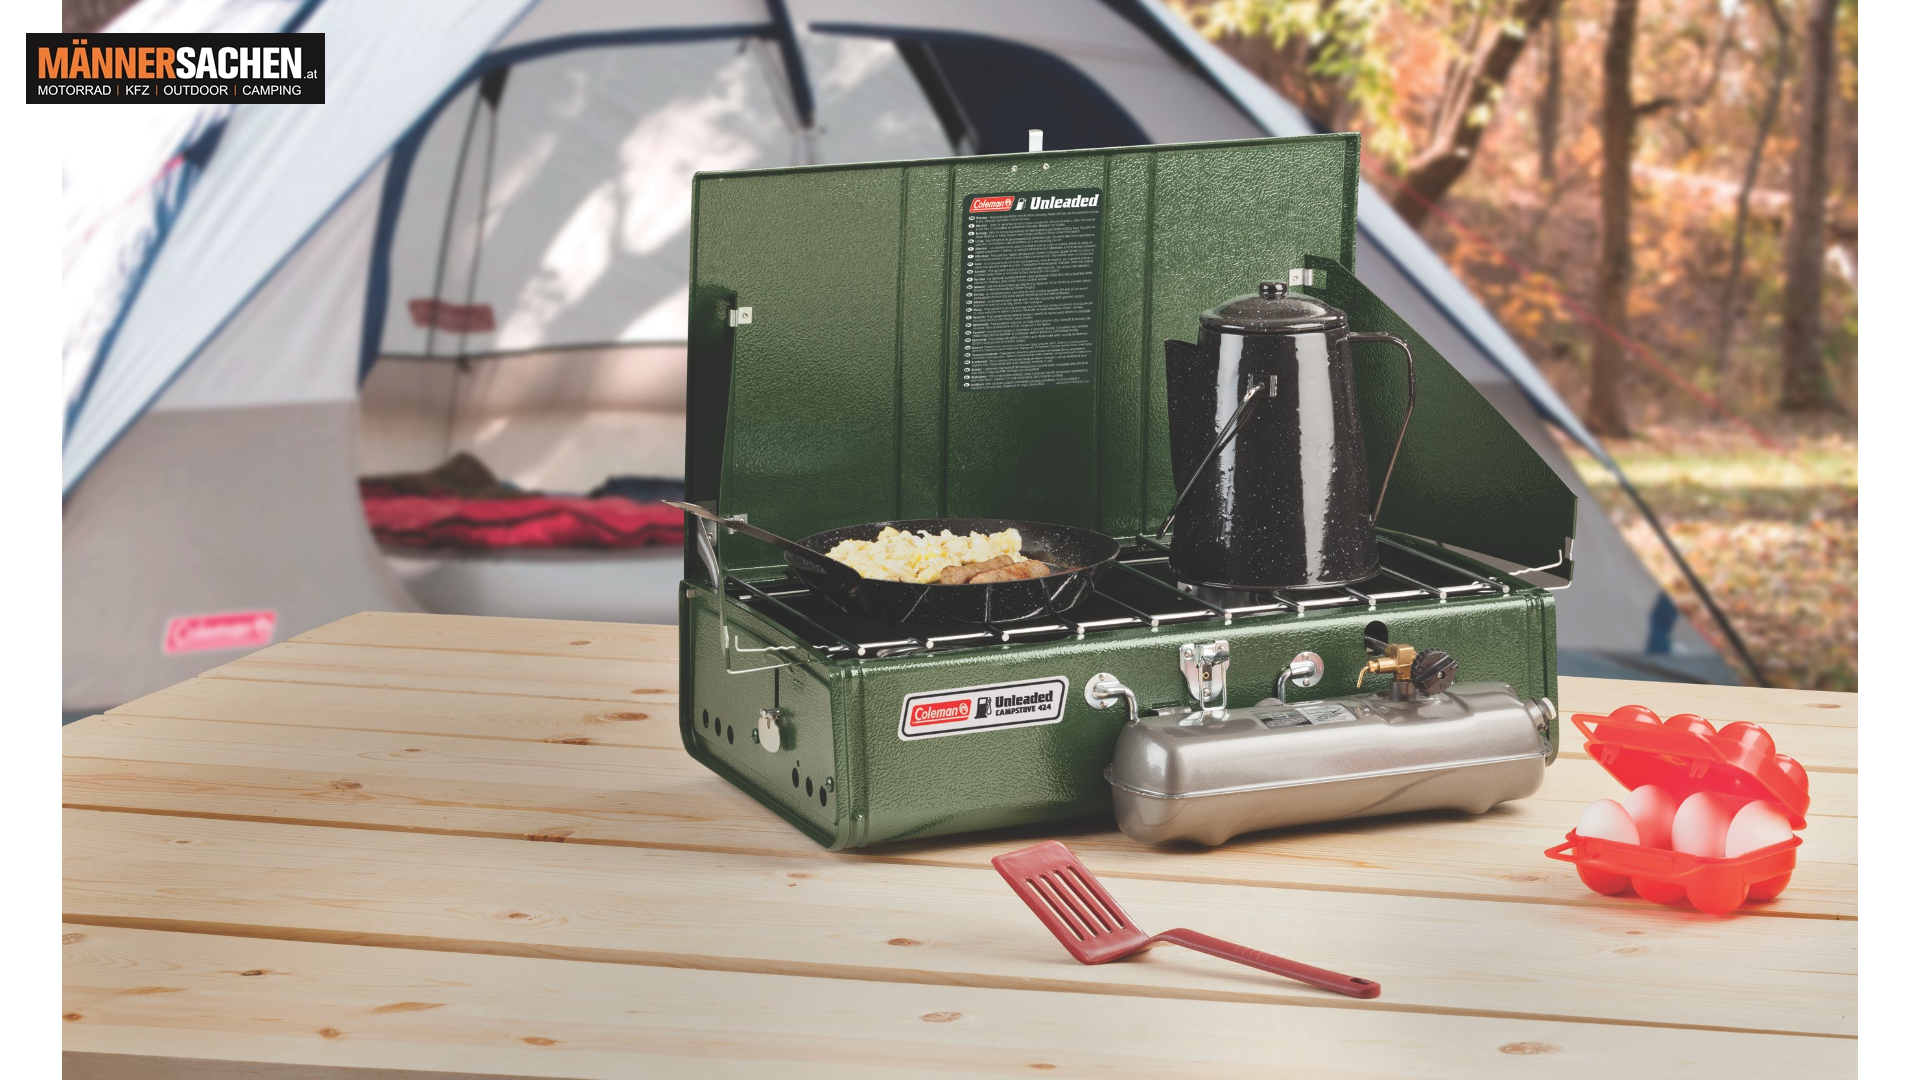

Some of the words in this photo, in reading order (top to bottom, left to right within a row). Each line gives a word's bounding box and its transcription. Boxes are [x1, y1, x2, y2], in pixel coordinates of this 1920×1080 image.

[973, 199, 1004, 209] Coleman
[1030, 194, 1100, 210] Unleaded
[914, 706, 959, 721] Coleman
[995, 690, 1053, 708] Unleaded
[996, 706, 1036, 716] CAMPSTOVE
[1037, 703, 1052, 711] 424
